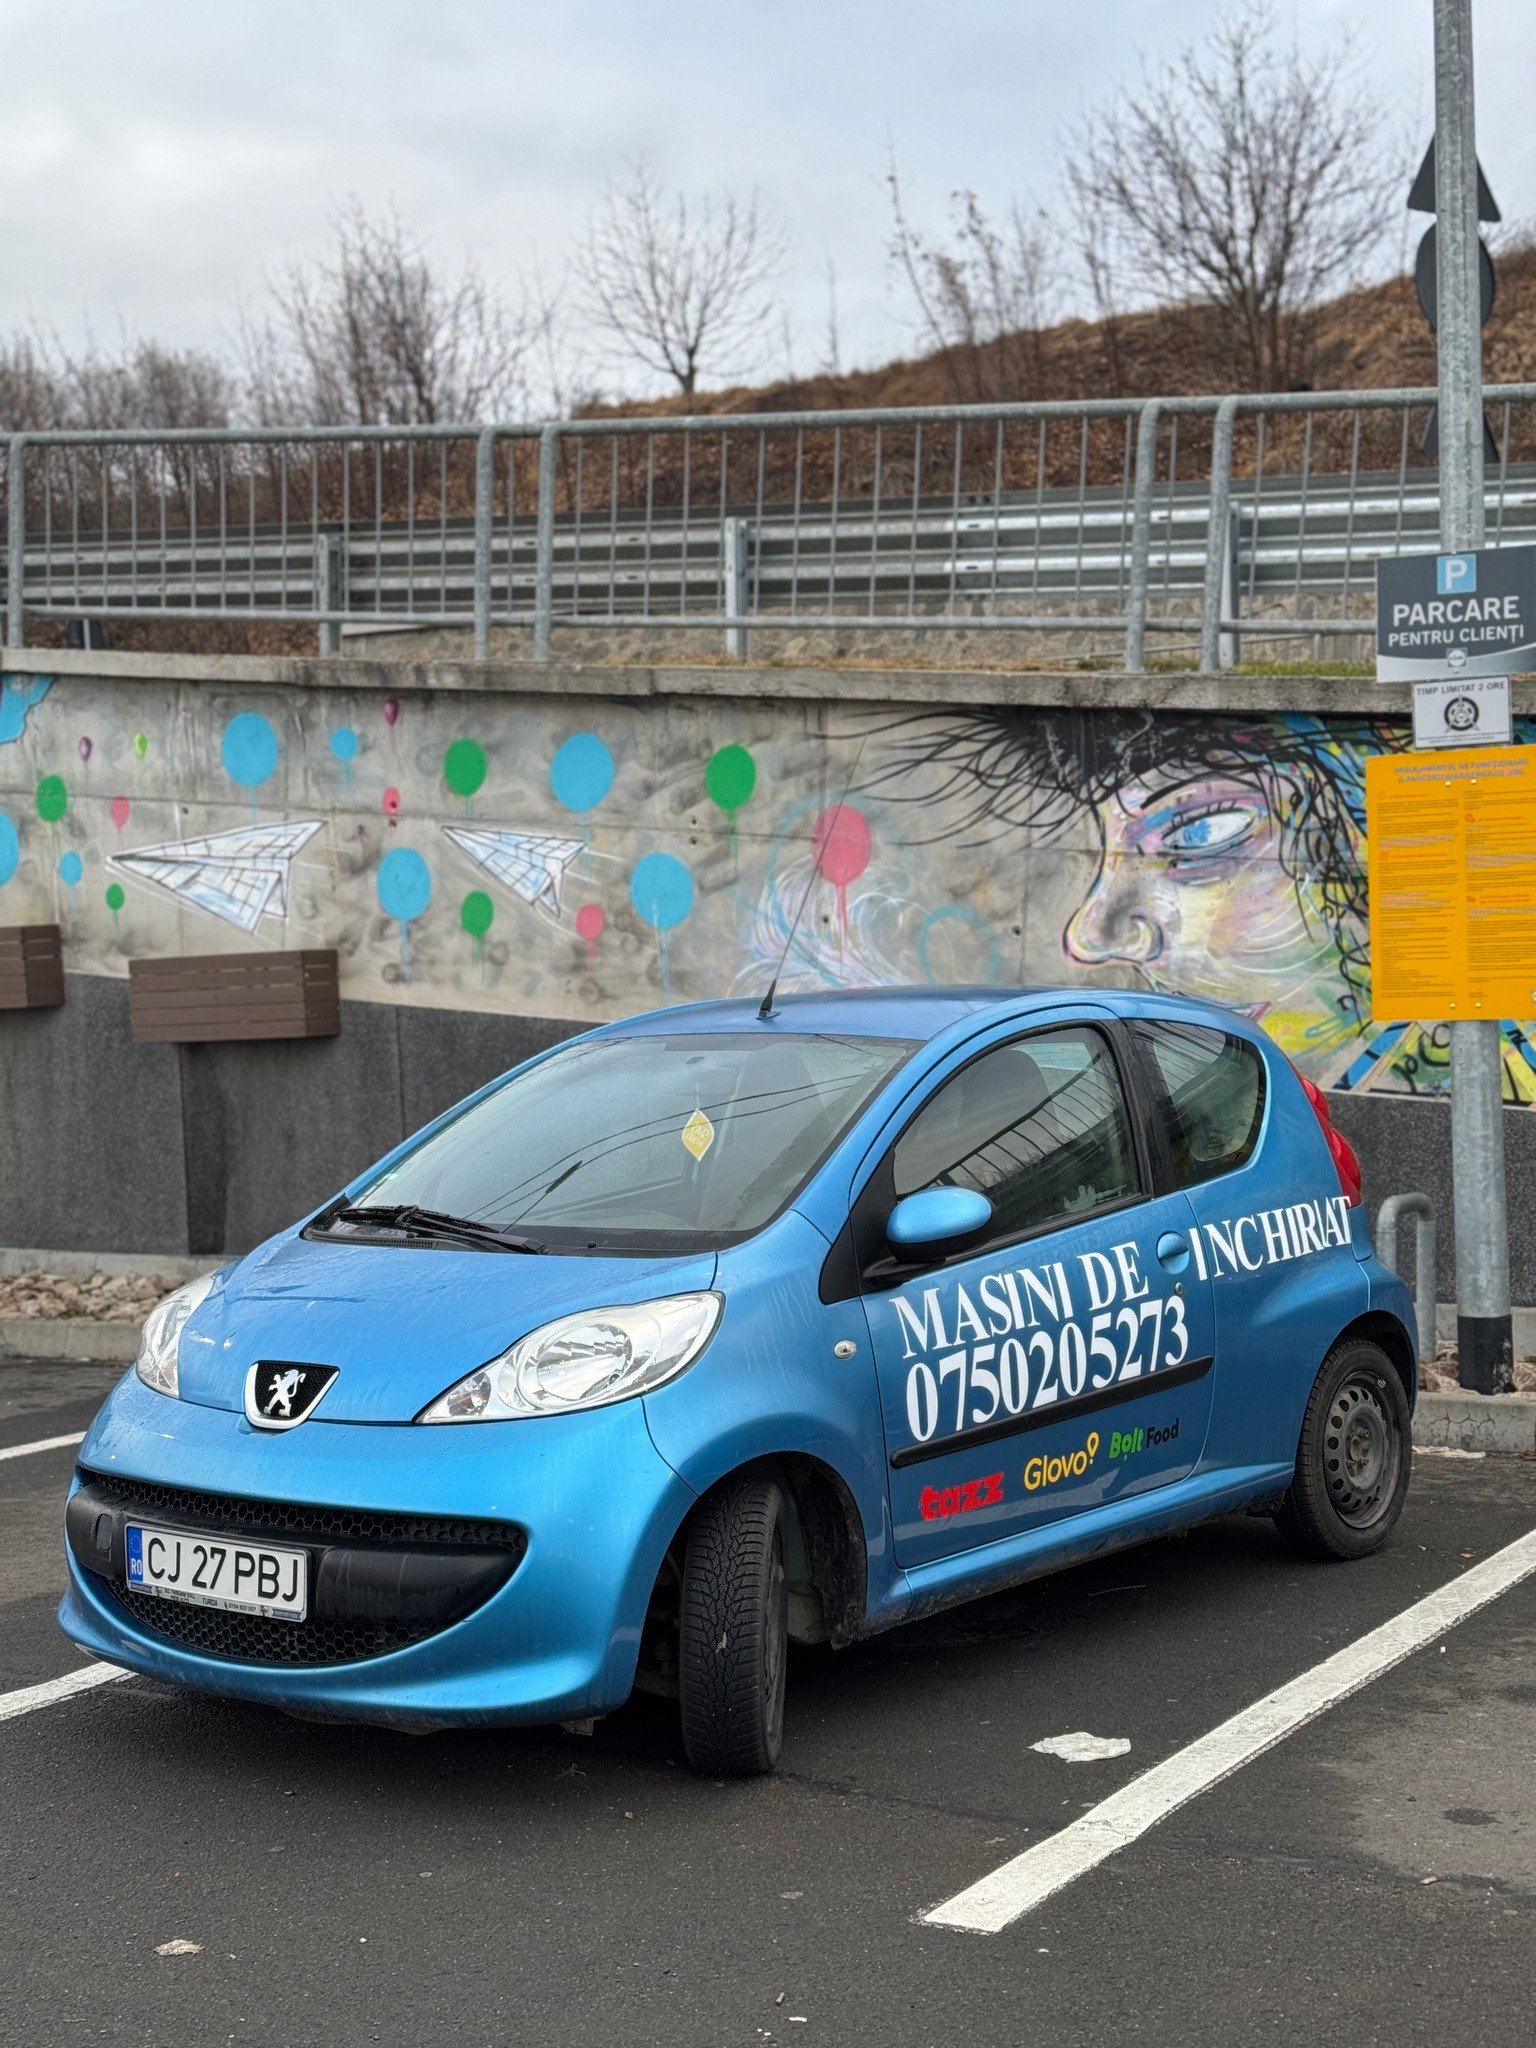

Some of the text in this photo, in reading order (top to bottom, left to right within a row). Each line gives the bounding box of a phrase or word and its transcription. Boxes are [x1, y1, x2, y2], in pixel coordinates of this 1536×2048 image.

[1445, 559, 1468, 590] P
[1393, 596, 1520, 627] PARCARE
[1388, 629, 1454, 647] PENTRU
[1417, 682, 1505, 696] TIMP LIMITAT 2 ORE
[889, 1195, 1352, 1359] MASINI DE INCHIRIAT
[905, 1295, 1189, 1442] 0750205273
[1108, 1418, 1180, 1461] Bolt Food
[919, 1472, 1005, 1521] tazz
[131, 1557, 142, 1576] RO
[147, 1537, 299, 1602] CJ 27 PBJ
